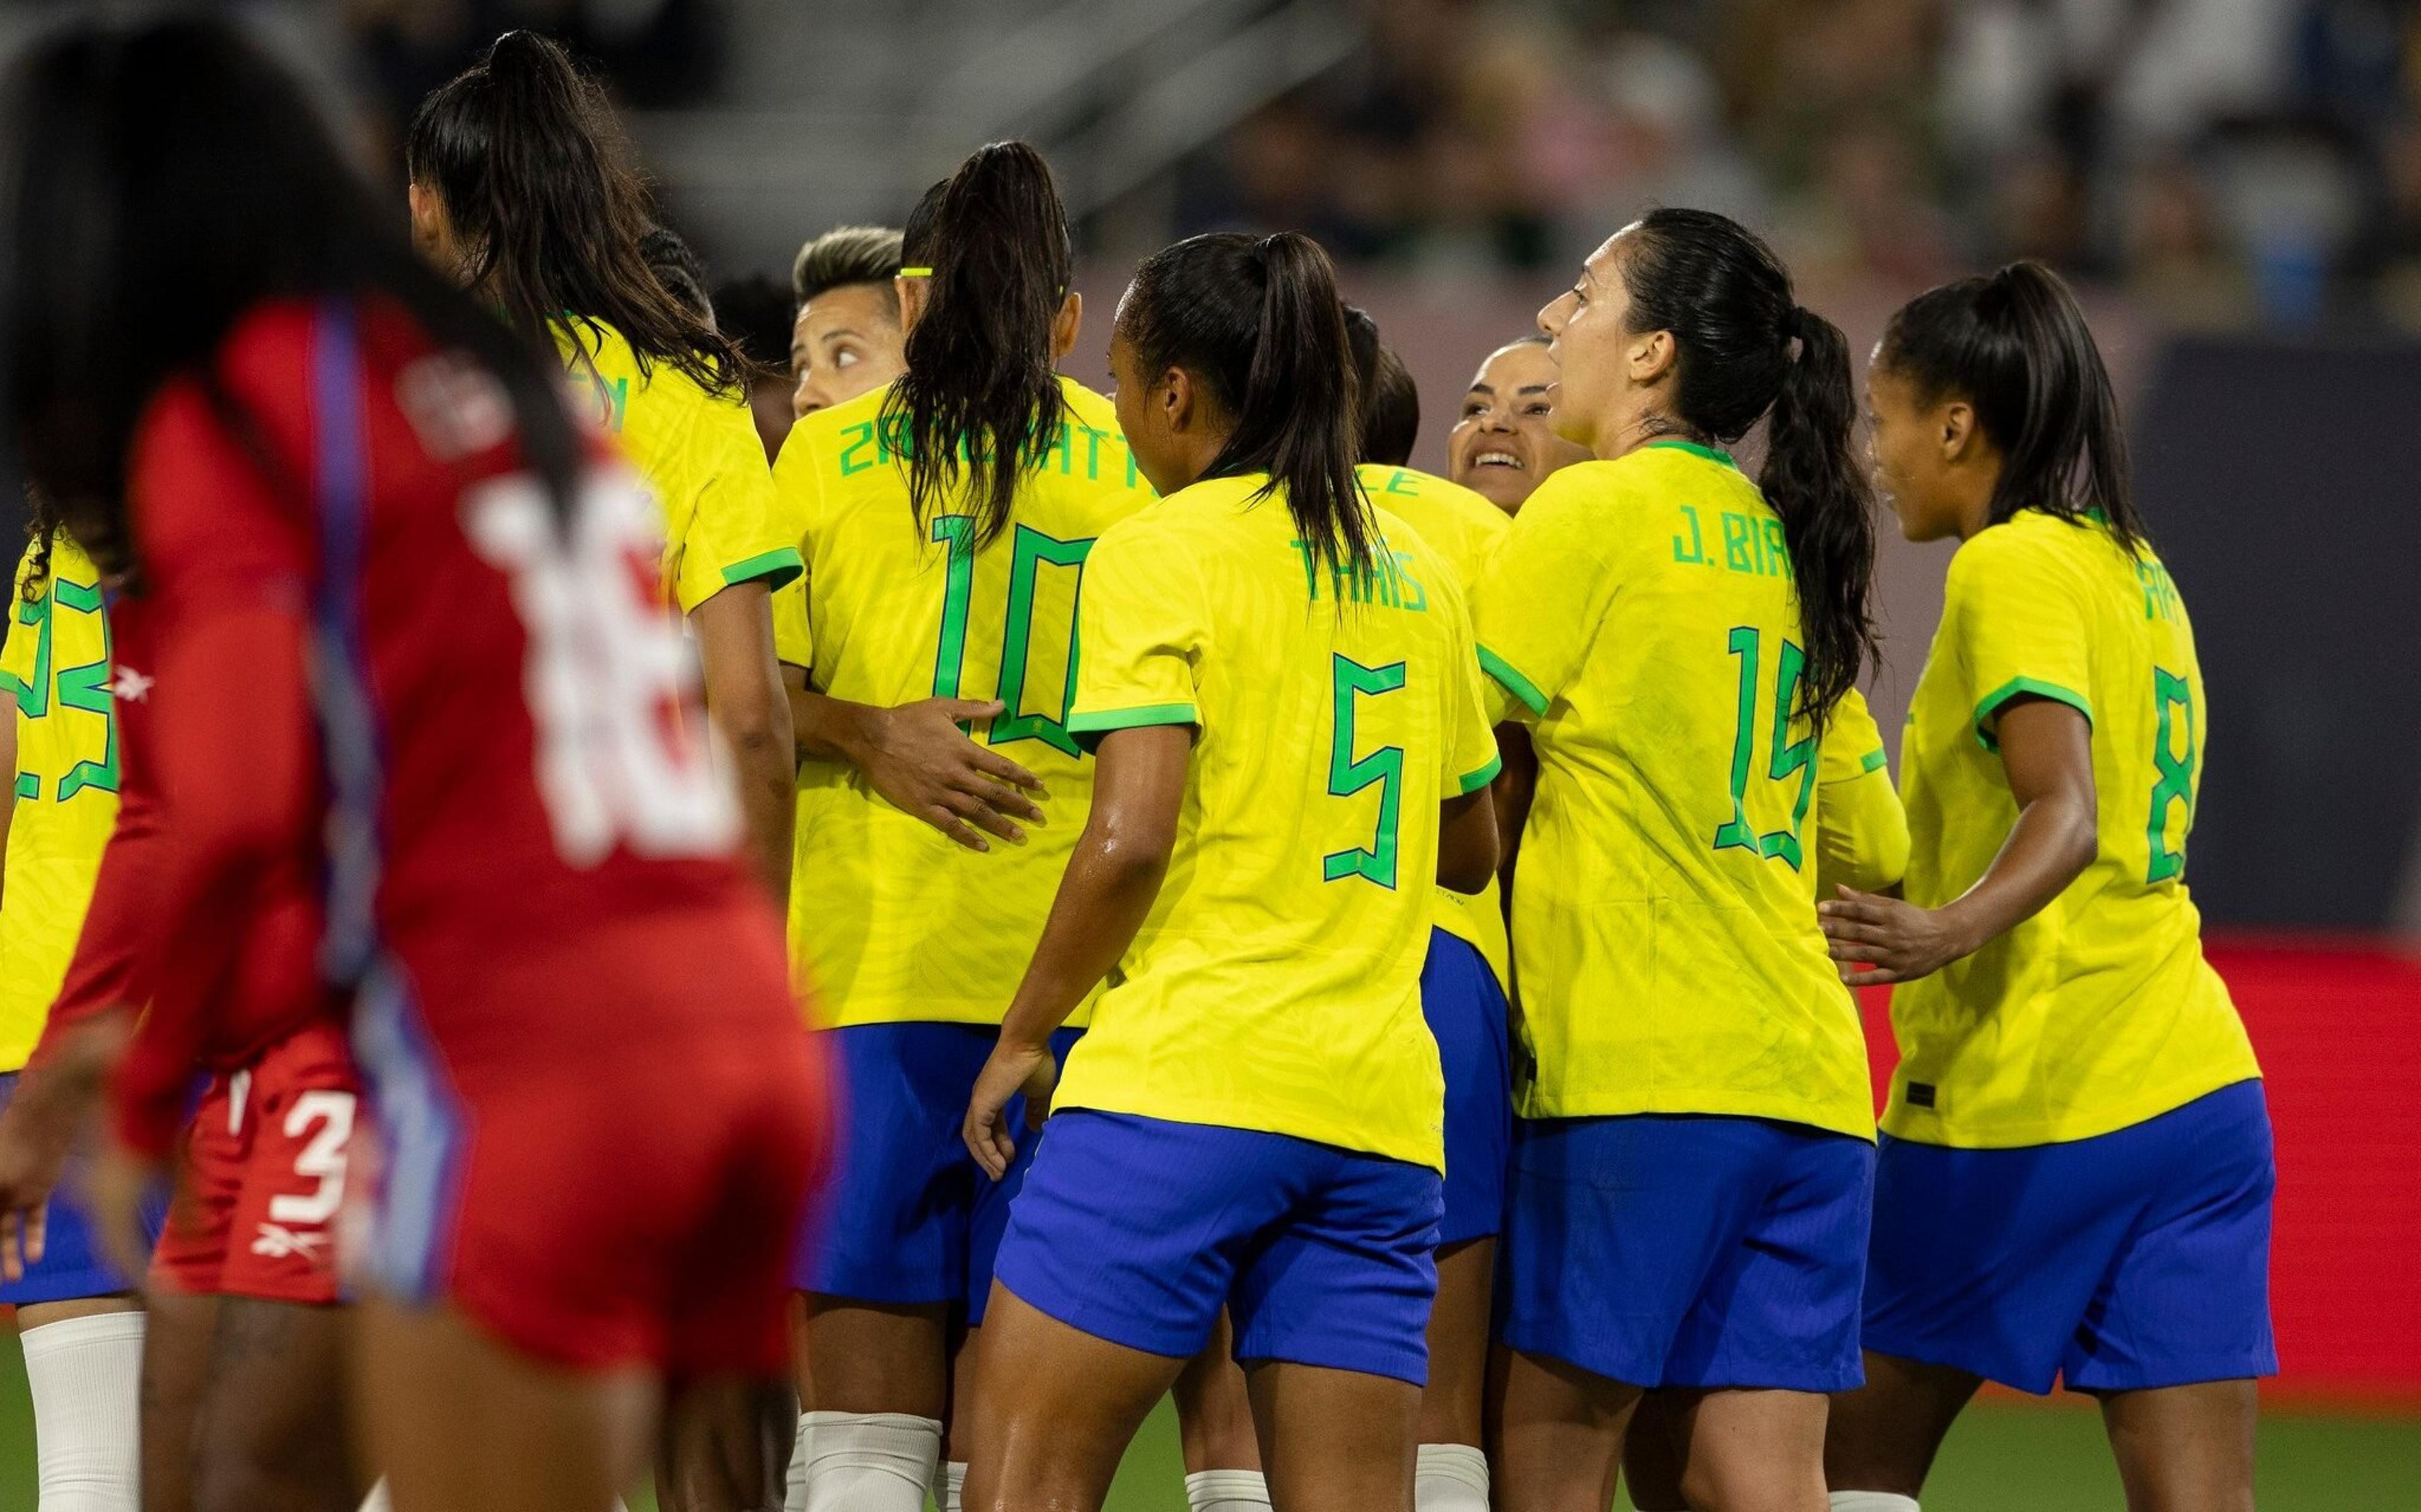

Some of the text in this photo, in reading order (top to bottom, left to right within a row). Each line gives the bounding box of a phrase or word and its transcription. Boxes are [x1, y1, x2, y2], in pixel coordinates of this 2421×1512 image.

[931, 513, 1101, 761] 10
[1712, 625, 1820, 874] 15
[1323, 652, 1406, 891] 5
[2146, 666, 2195, 884] 8
[268, 1090, 357, 1223] 3
